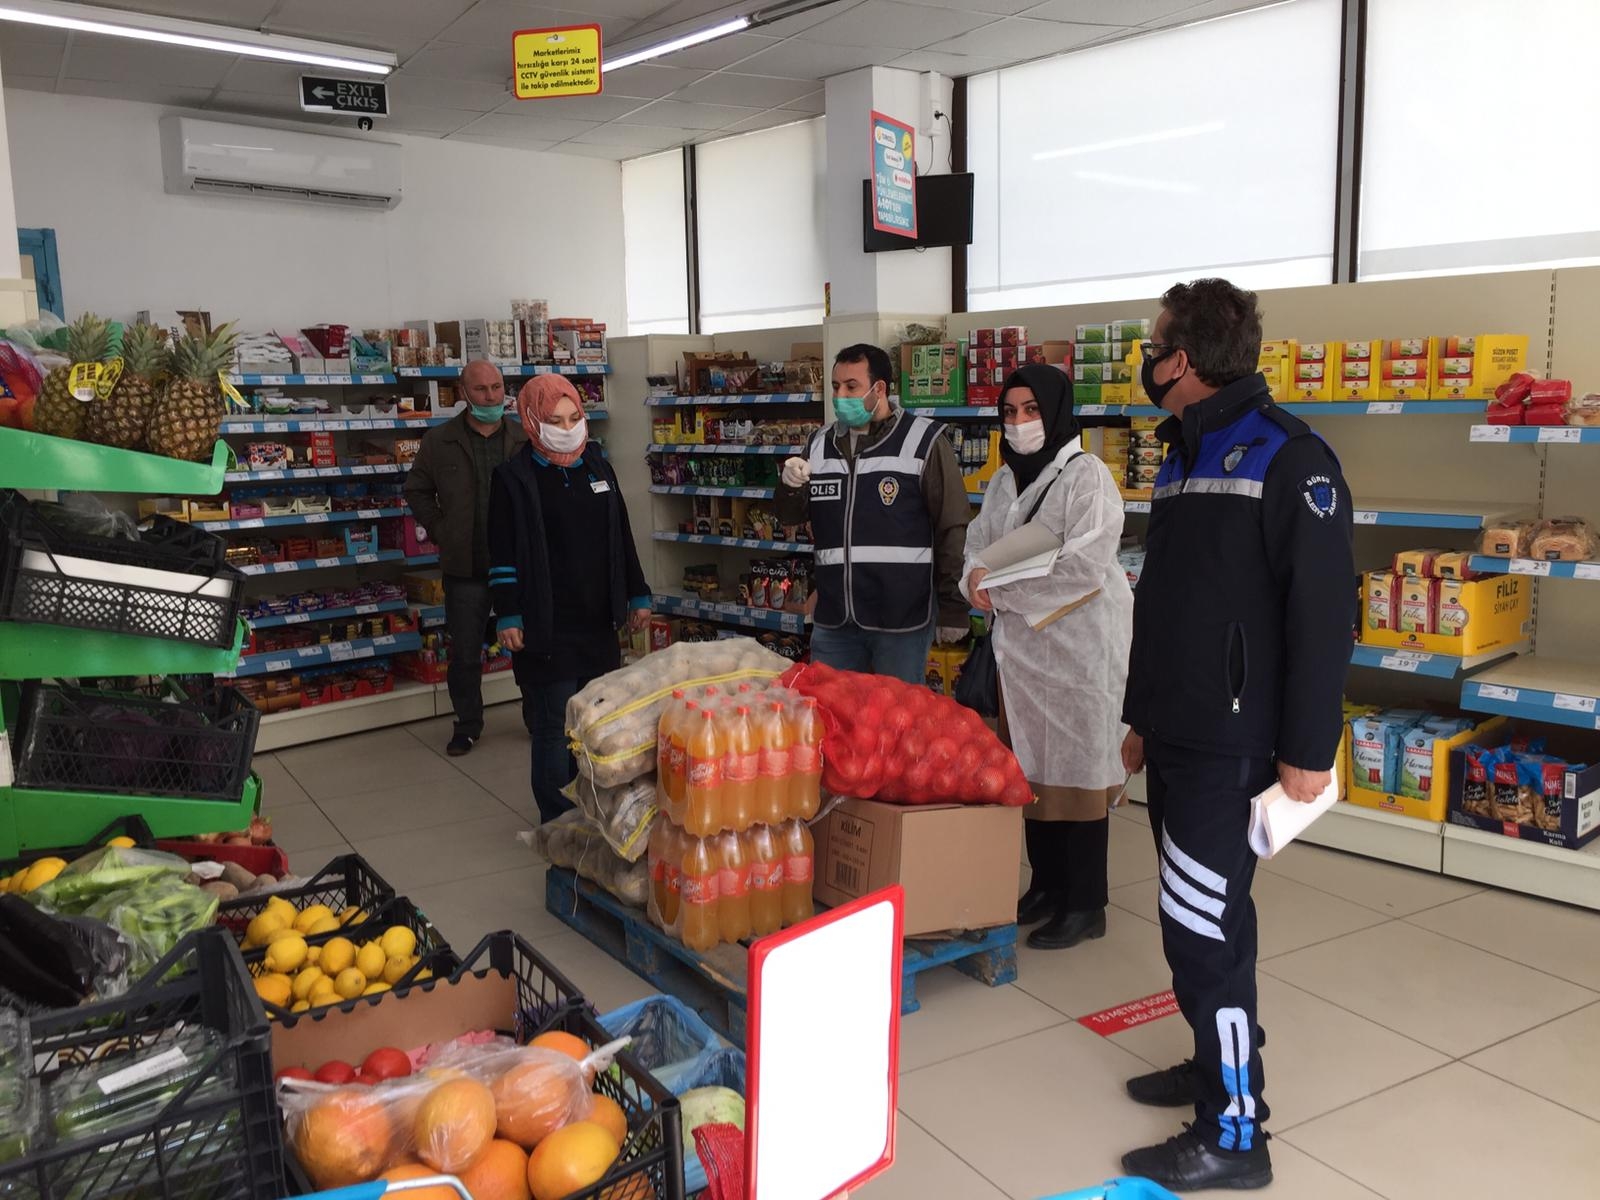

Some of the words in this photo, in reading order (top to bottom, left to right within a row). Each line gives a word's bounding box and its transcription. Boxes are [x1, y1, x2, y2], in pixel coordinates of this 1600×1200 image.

[533, 47, 580, 57] Marketlerimiz
[517, 60, 549, 69] hırsızlığa
[551, 59, 568, 68] karşı
[571, 57, 580, 65] 24
[582, 57, 597, 65] saat
[521, 71, 538, 80] CCTV
[540, 69, 569, 80] güvenlik
[571, 66, 595, 76] sistemi
[337, 82, 375, 97] EXIT
[521, 82, 529, 90] ile
[531, 81, 549, 91] takip
[551, 77, 596, 89] edilmektedir.
[336, 95, 379, 111] ÇIKIŞ
